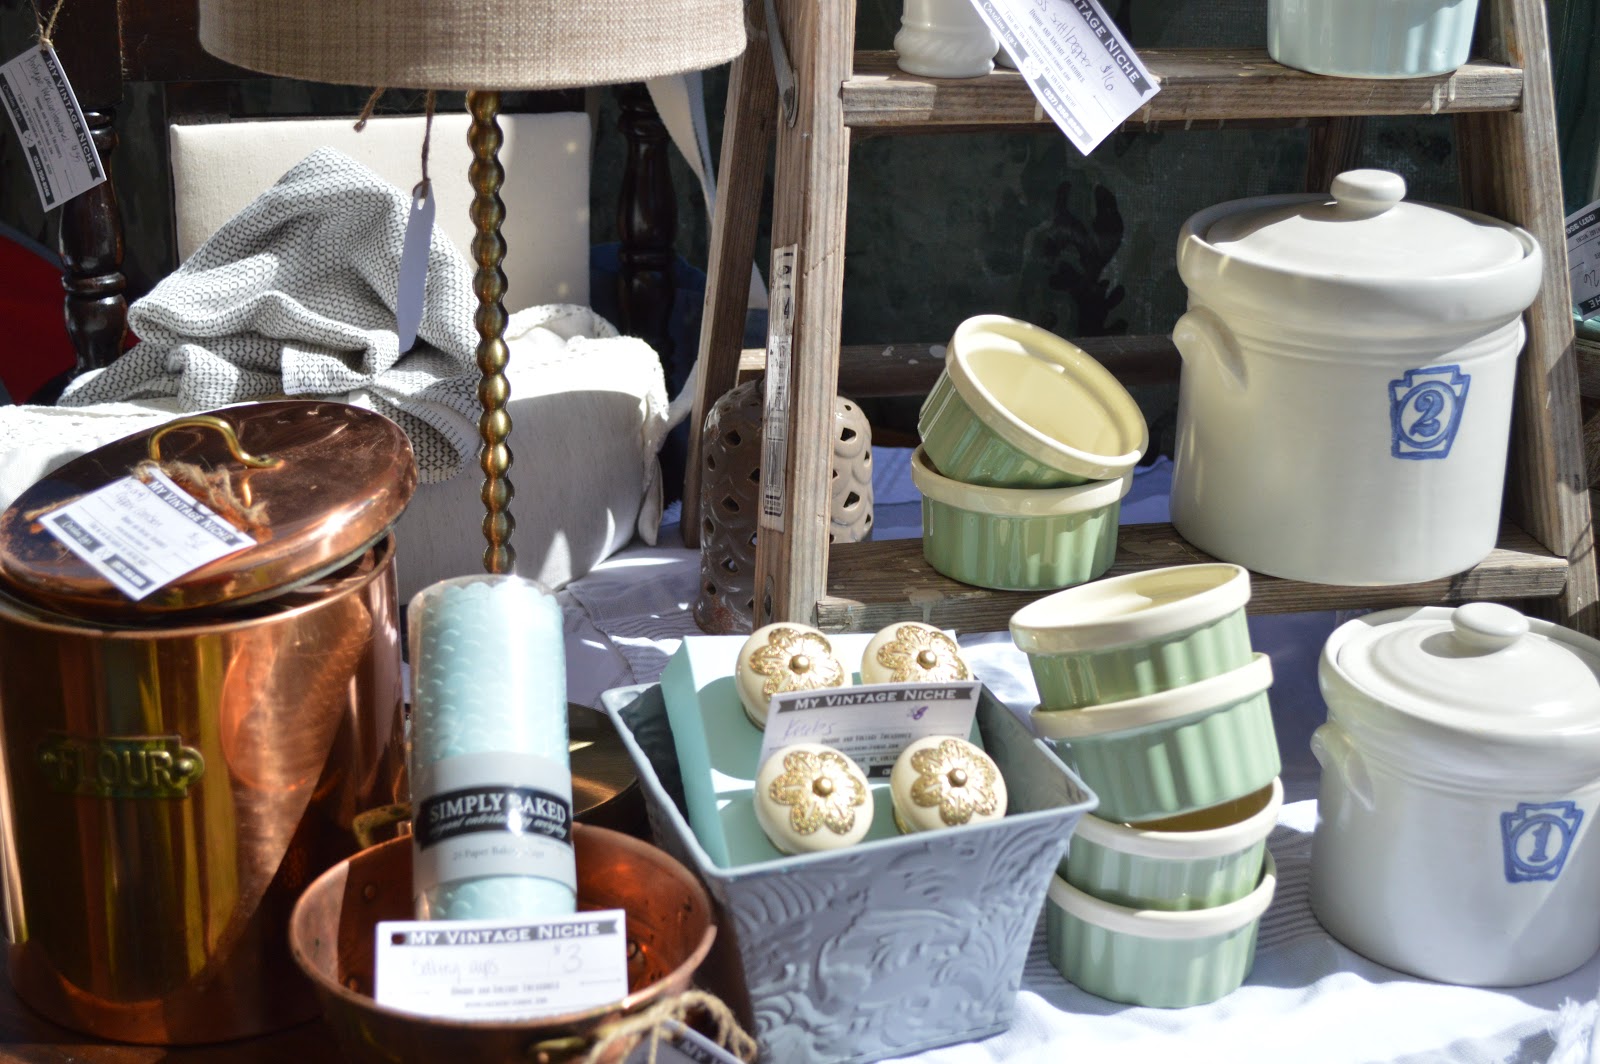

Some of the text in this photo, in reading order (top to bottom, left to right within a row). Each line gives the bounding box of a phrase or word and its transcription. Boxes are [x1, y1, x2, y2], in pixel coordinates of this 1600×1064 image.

[1042, 27, 1051, 38] AND
[1073, 0, 1141, 83] TAGE NICHE
[47, 59, 58, 76] MY
[57, 81, 79, 131] VINTAGE
[79, 134, 95, 169] NICHE
[1409, 389, 1445, 438] 2
[149, 481, 165, 498] MY
[166, 492, 202, 523] VINTAGE
[200, 517, 235, 542] NICHE
[794, 689, 956, 710] MY VINTAGE NICHE
[56, 746, 173, 787] FLOUR
[429, 792, 566, 823] SIMPLY BAKED
[1527, 821, 1551, 863] 1
[411, 921, 601, 945] MY VINTAGE NICHE
